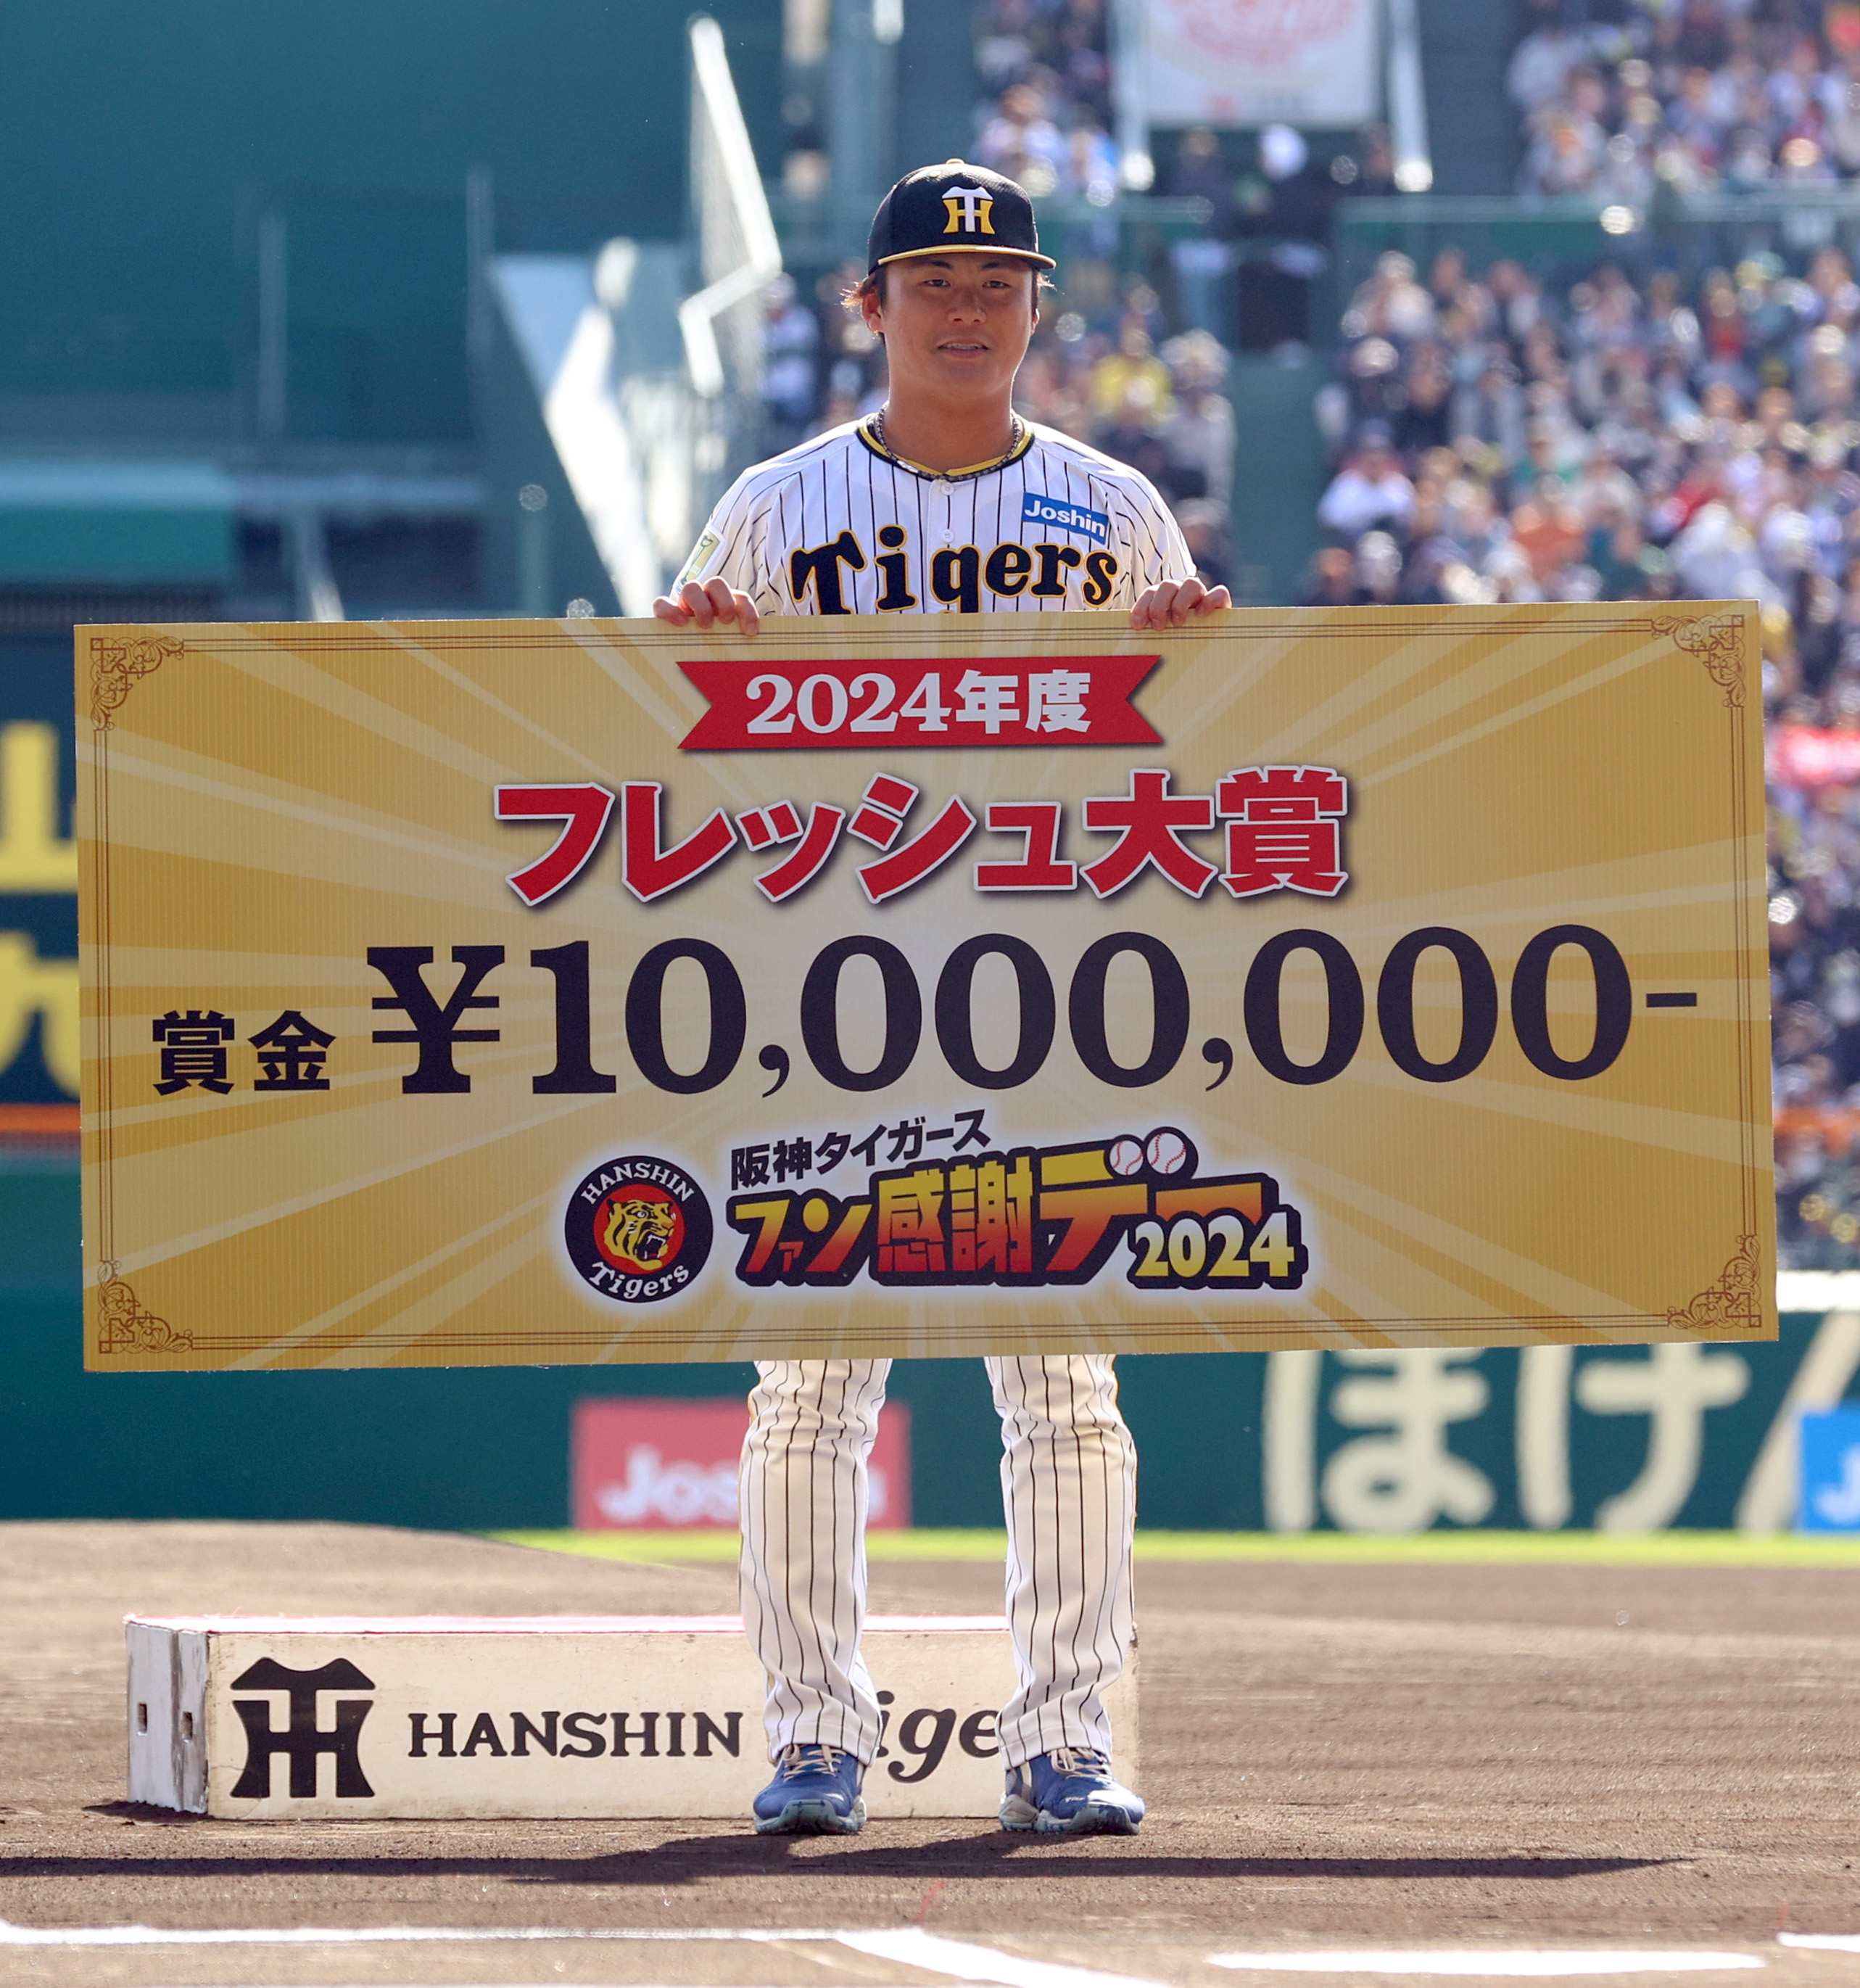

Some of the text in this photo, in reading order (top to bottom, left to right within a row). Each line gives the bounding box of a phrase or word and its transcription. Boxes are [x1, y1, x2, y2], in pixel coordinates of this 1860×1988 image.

[1024, 500, 1107, 537] Joshin
[790, 524, 1120, 614] Tigers
[745, 669, 1092, 735] 2024年度
[494, 764, 1348, 907] フレッシュ大賞
[152, 1010, 336, 1096] 賞金
[731, 1109, 991, 1191] 阪神タイガース
[581, 1162, 695, 1205] HANSHIN
[1135, 1211, 1295, 1277] 2024
[589, 1261, 690, 1299] Tigers
[408, 1711, 743, 1758] HANSHIN
